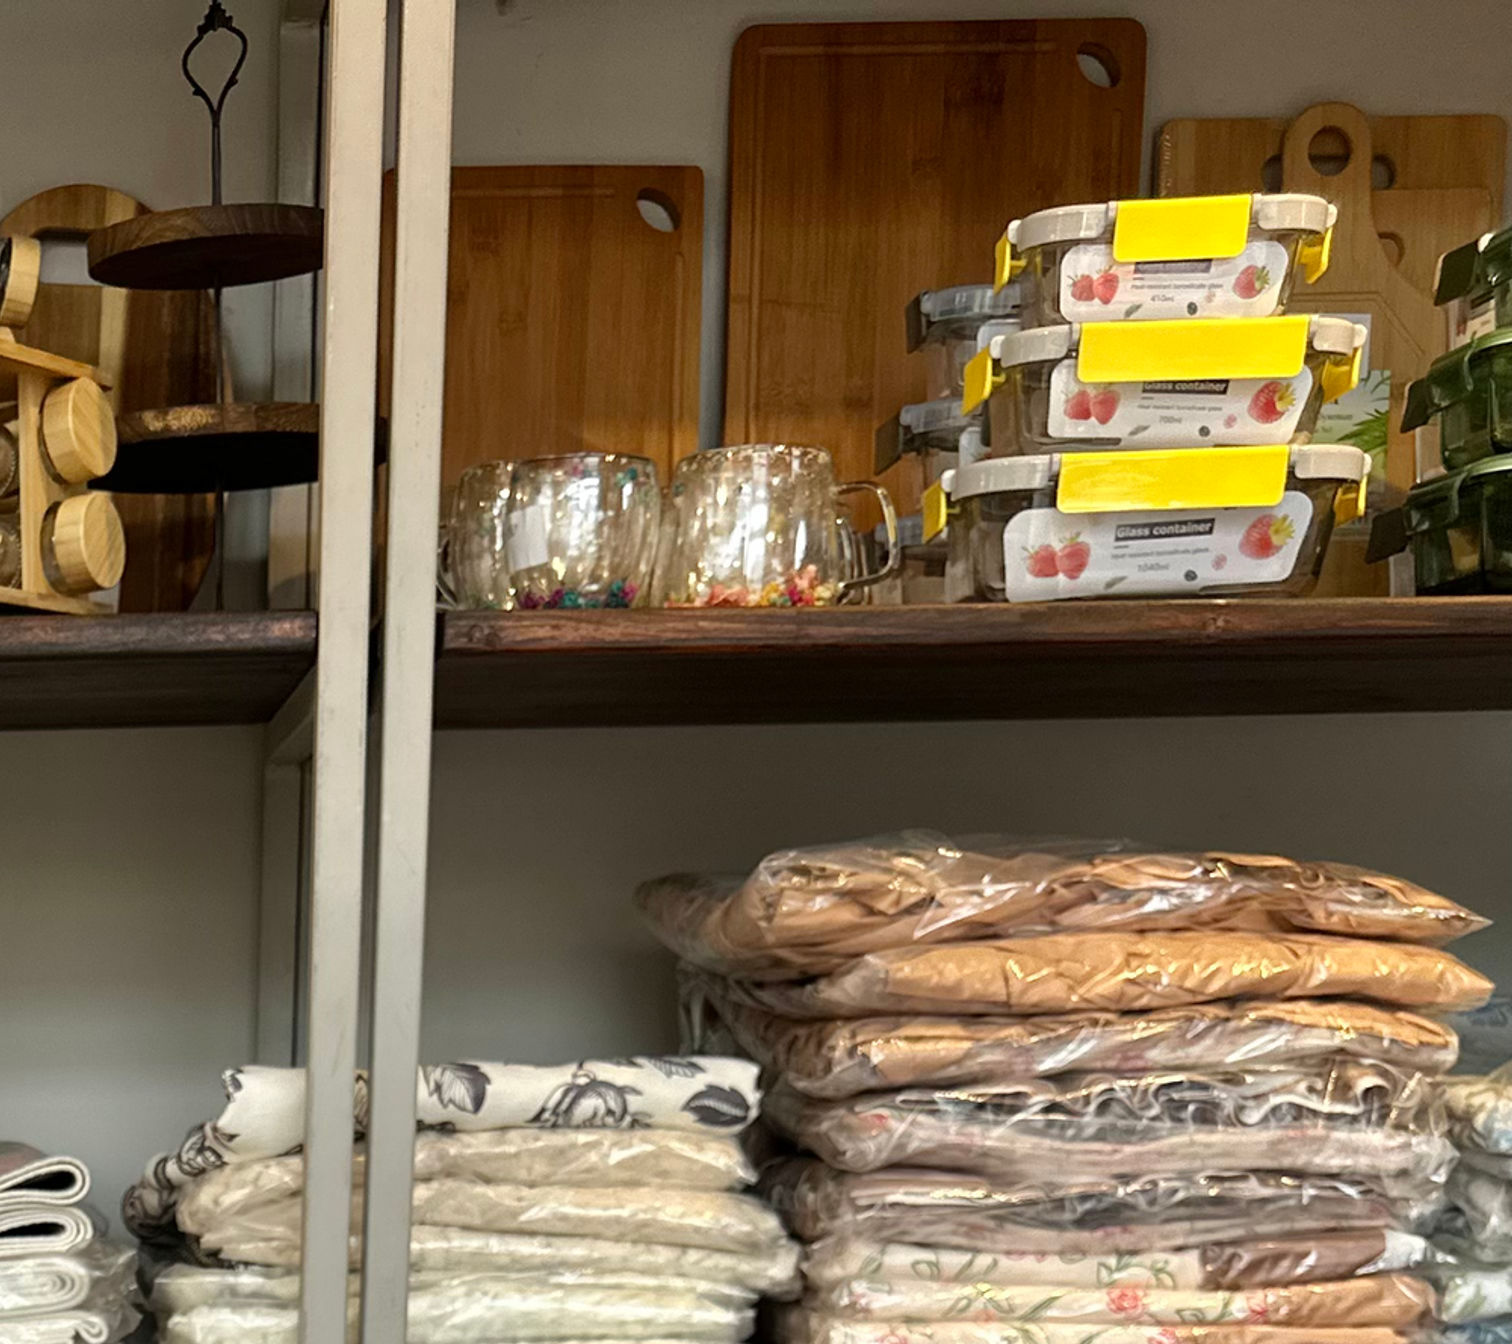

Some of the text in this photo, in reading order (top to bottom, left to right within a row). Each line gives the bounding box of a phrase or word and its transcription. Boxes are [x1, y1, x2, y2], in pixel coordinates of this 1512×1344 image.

[1144, 380, 1227, 392] Glass container
[1116, 521, 1212, 539] Glass container
